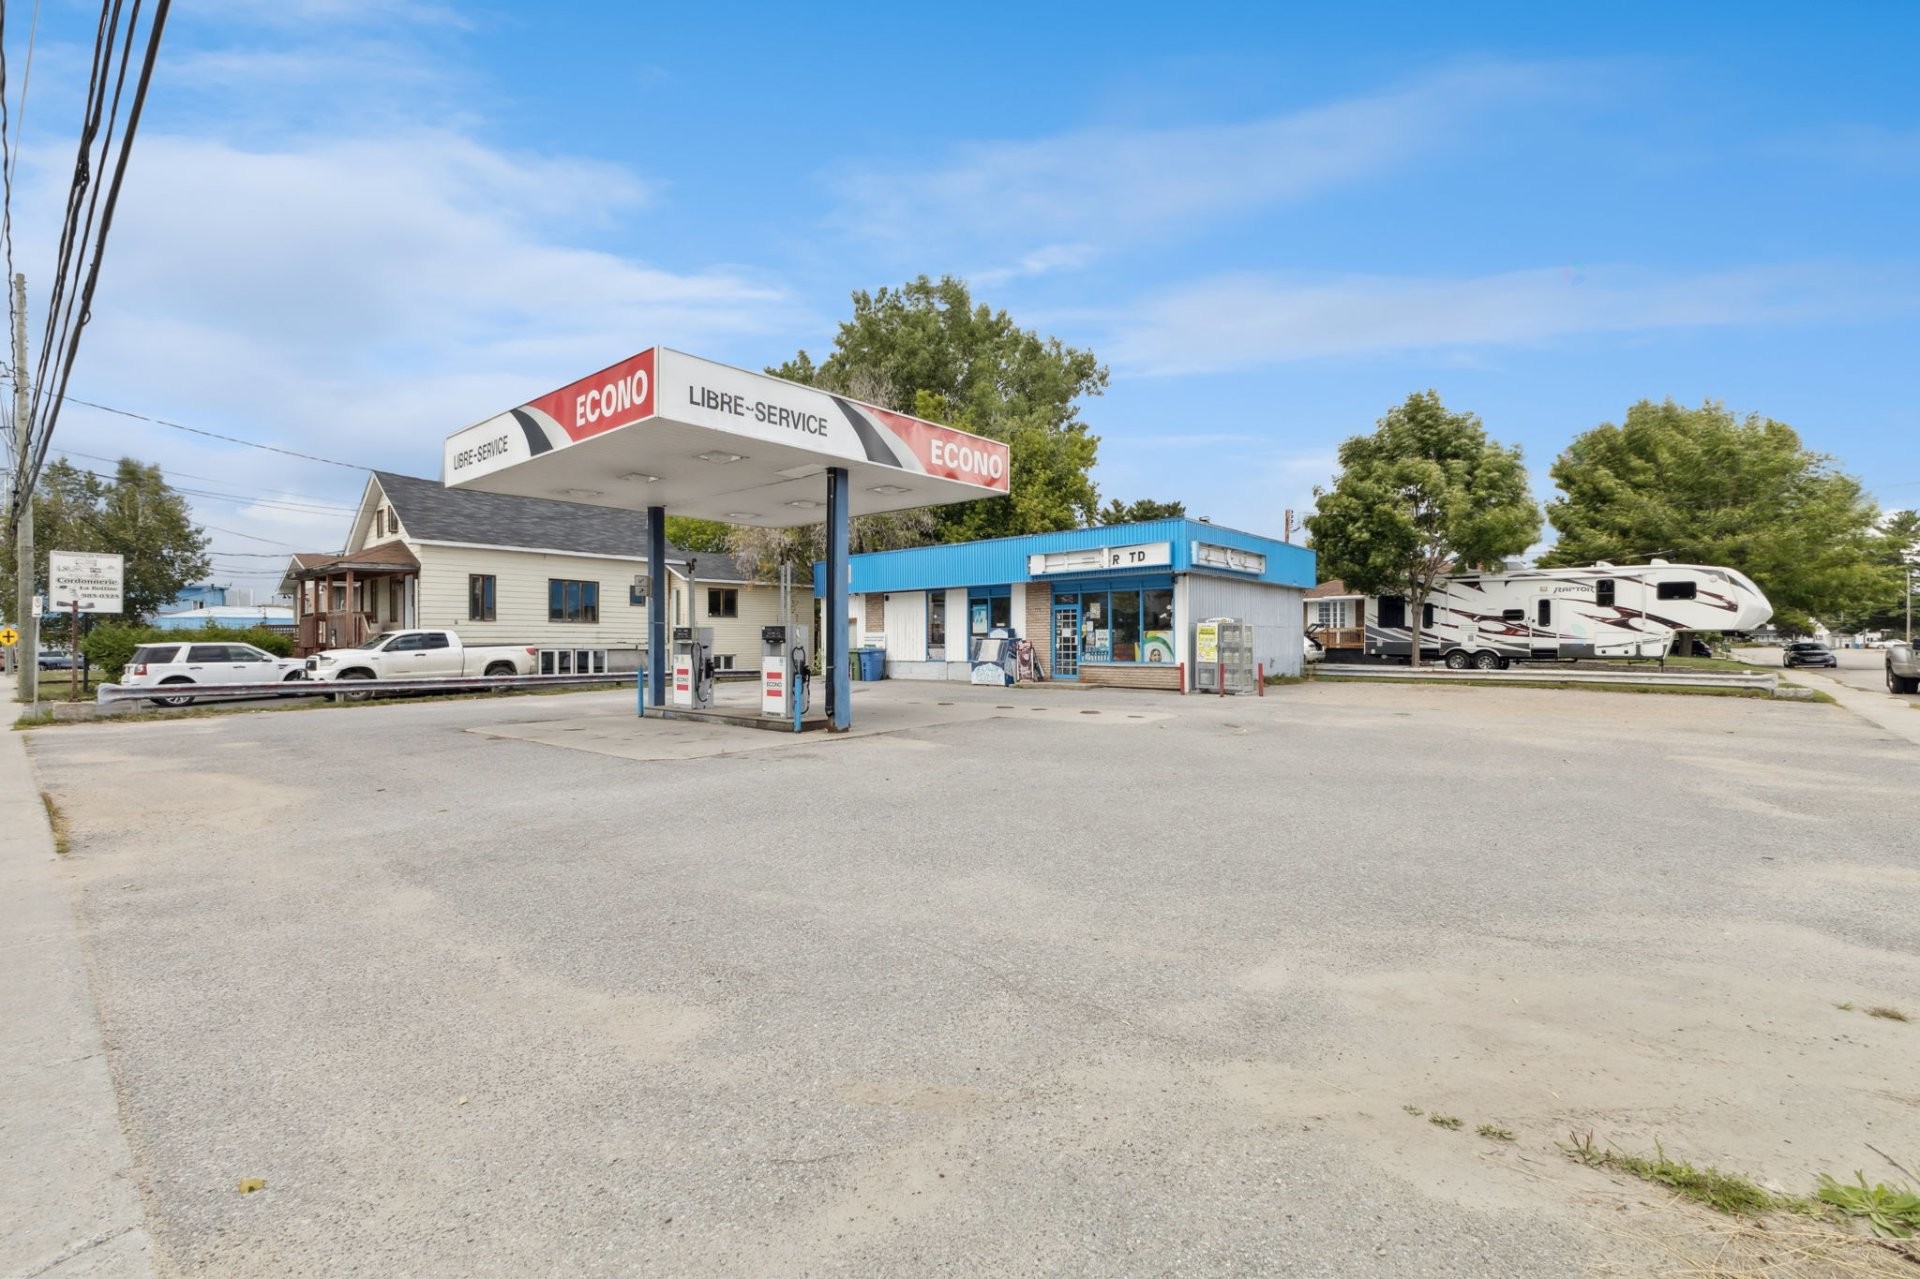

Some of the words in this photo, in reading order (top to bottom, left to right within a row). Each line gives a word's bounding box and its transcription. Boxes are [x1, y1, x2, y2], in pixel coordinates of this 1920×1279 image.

[576, 369, 648, 428] ECONO
[689, 385, 828, 437] LIBRE-SERVICE
[453, 435, 509, 470] LIBRE-SERVICE
[931, 439, 1003, 479] ECONO
[1112, 554, 1120, 565] R
[1129, 550, 1146, 563] TD
[57, 577, 118, 585] Cordonnerie
